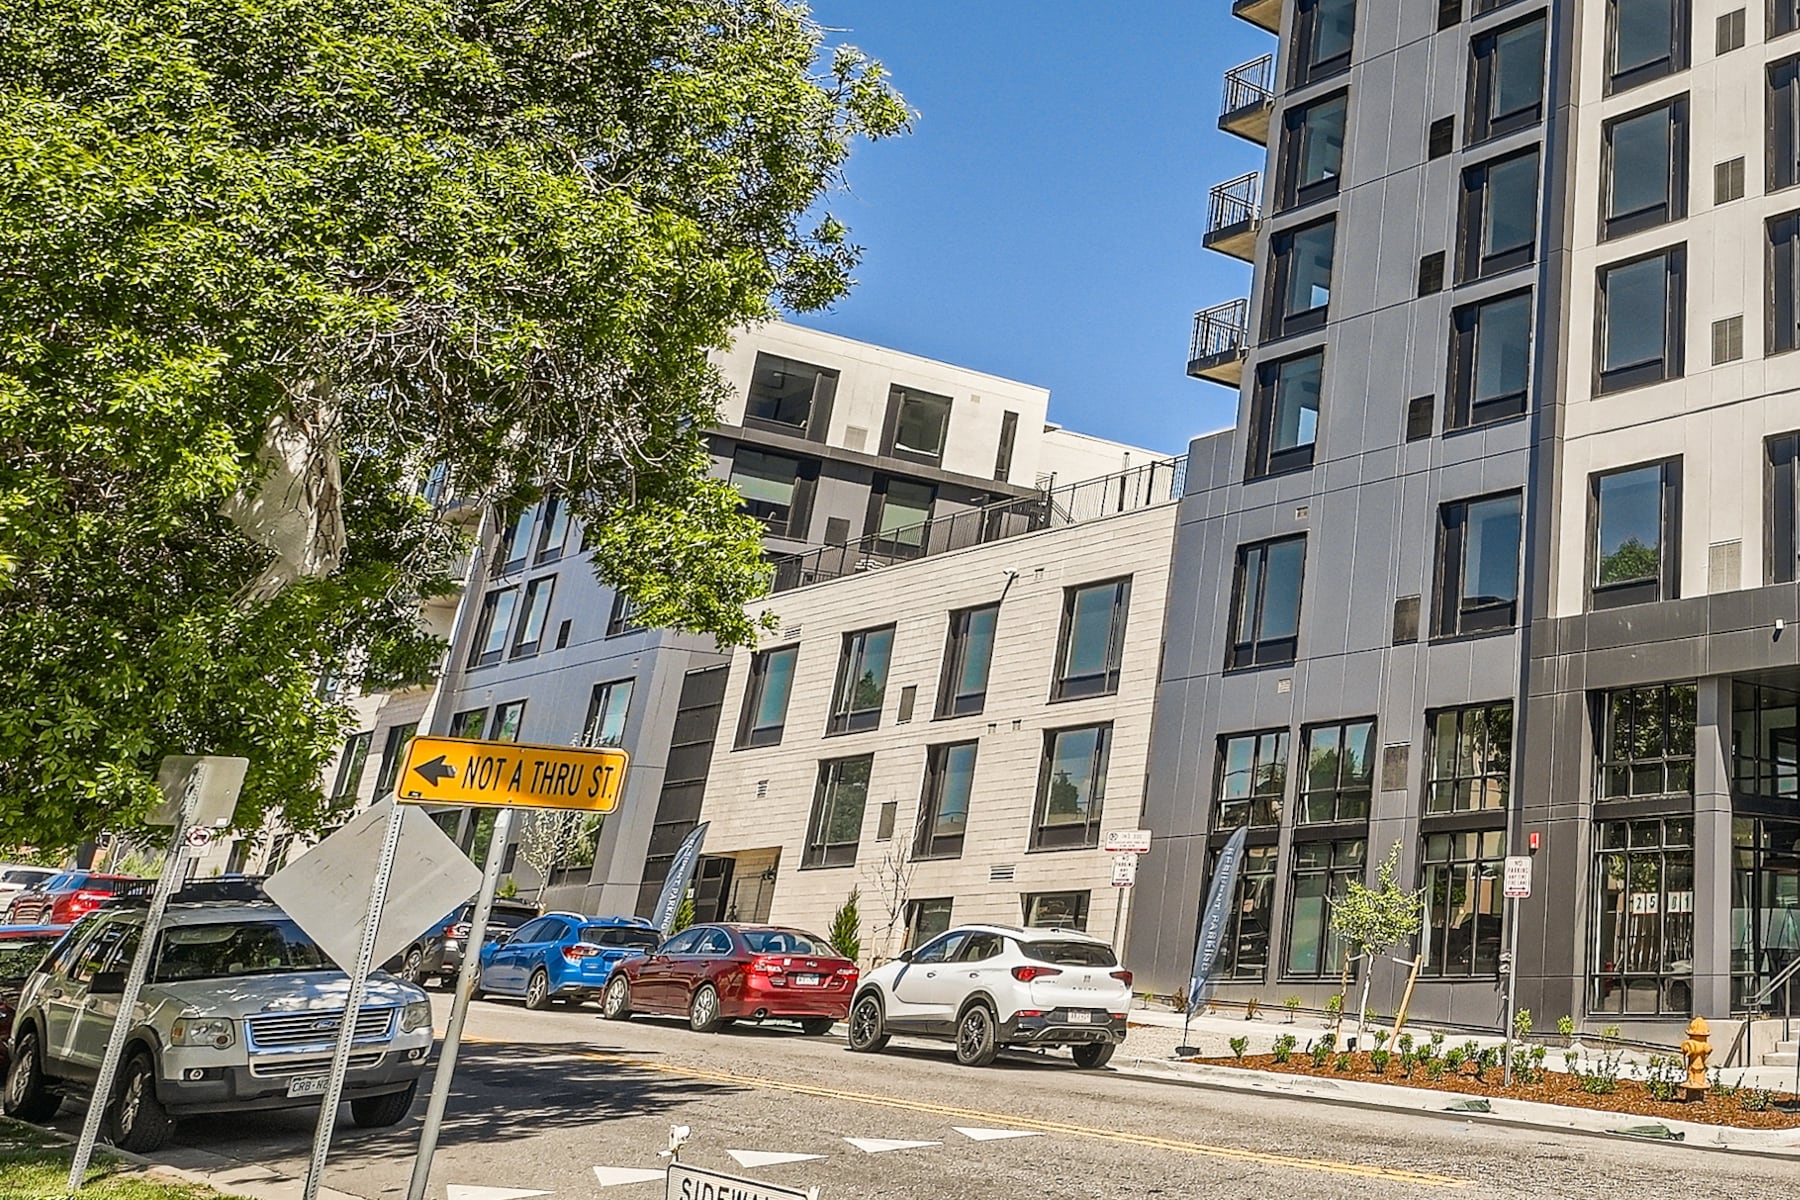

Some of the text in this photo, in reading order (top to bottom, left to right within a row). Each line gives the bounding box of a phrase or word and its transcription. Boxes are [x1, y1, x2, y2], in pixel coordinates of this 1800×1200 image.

[461, 755, 614, 799] NOT A THRU ST.
[661, 887, 679, 930] PARKING
[1201, 914, 1219, 972] PARKING
